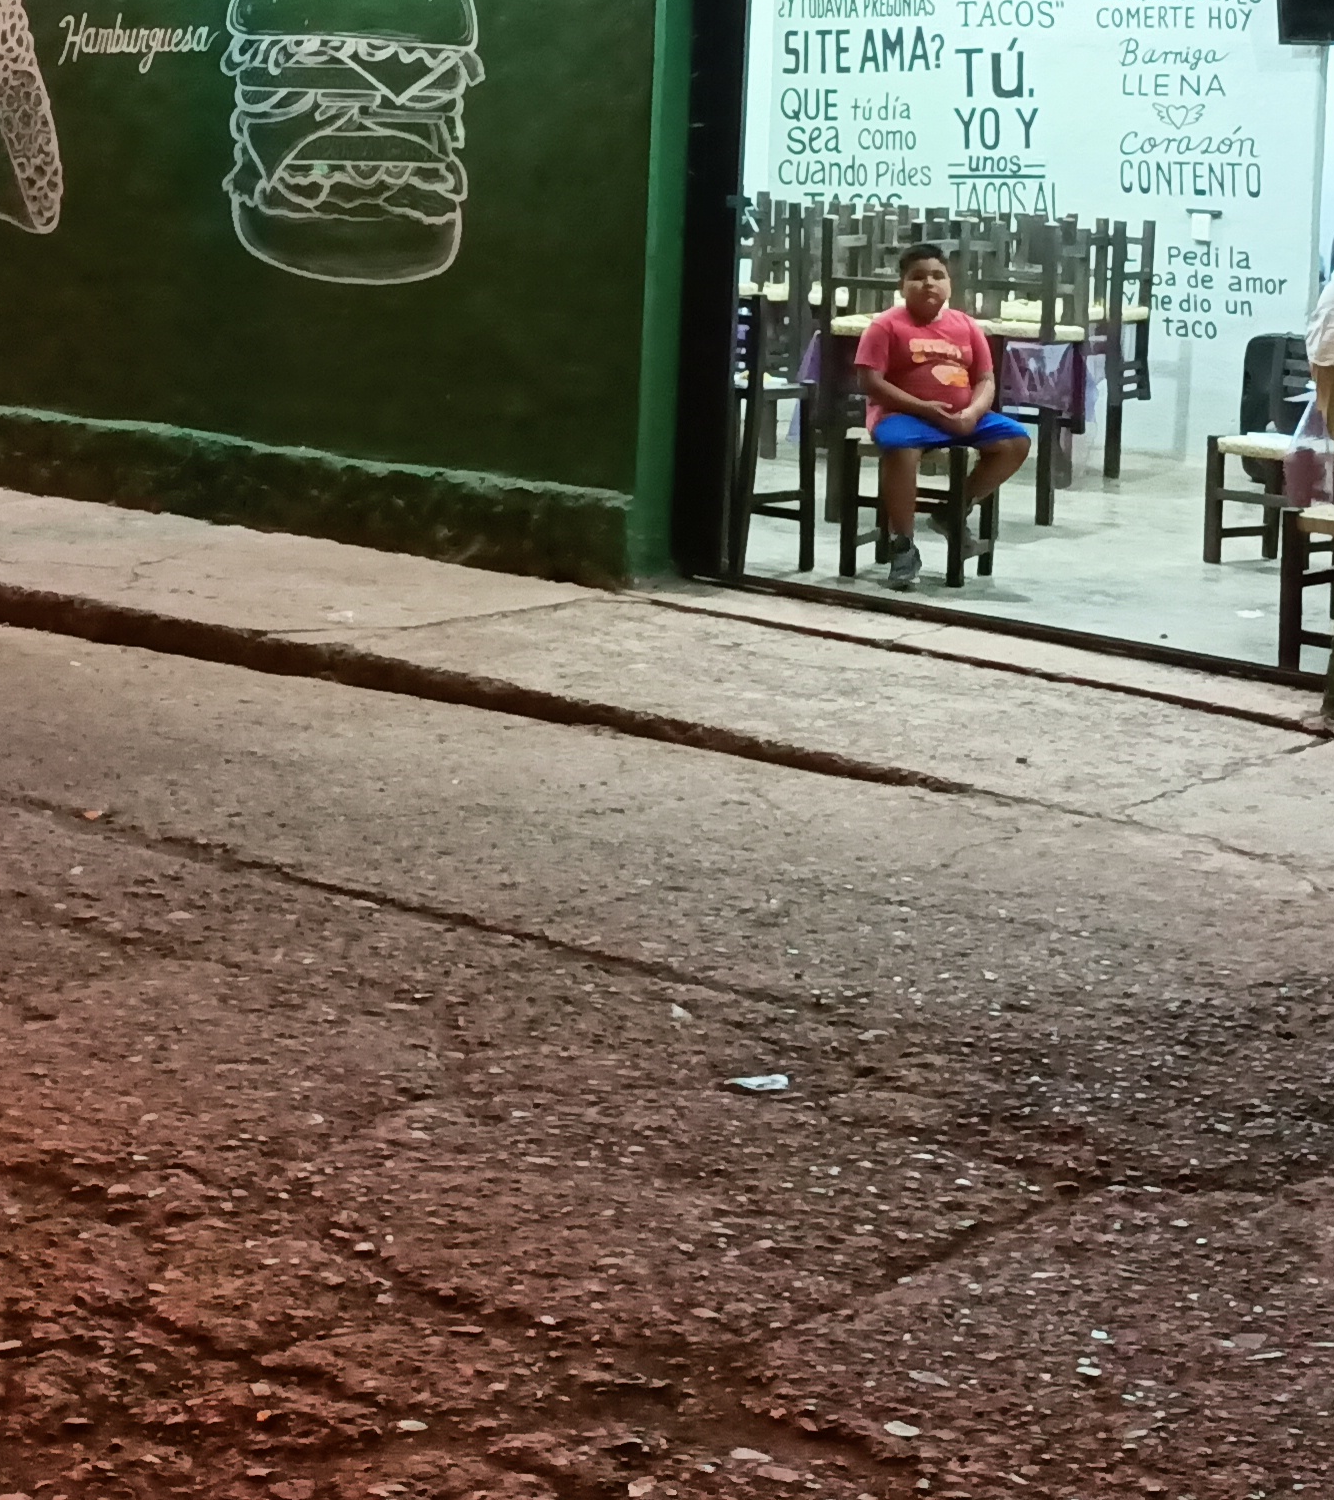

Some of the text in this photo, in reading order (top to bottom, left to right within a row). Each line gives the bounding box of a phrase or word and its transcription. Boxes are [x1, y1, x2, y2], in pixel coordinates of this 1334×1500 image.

[1096, 6, 1253, 32] COMERTE HOY
[58, 12, 221, 74] Hamburguesa
[859, 25, 945, 74] AMA?
[1118, 37, 1230, 70] Barriga
[1122, 74, 1227, 97] LLENA
[780, 88, 911, 122] QUE tú día
[954, 107, 1039, 150] YO Y
[1119, 125, 1261, 158] Corazón
[968, 155, 1022, 175] unos
[1120, 159, 1261, 198] CONTENTO
[950, 181, 1026, 216] TACOS
[1167, 243, 1252, 270] Pedi la
[1187, 269, 1214, 290] de
[1228, 275, 1288, 295] amor
[1179, 293, 1212, 313] dio
[1225, 299, 1253, 317] un
[1163, 317, 1218, 340] taco
